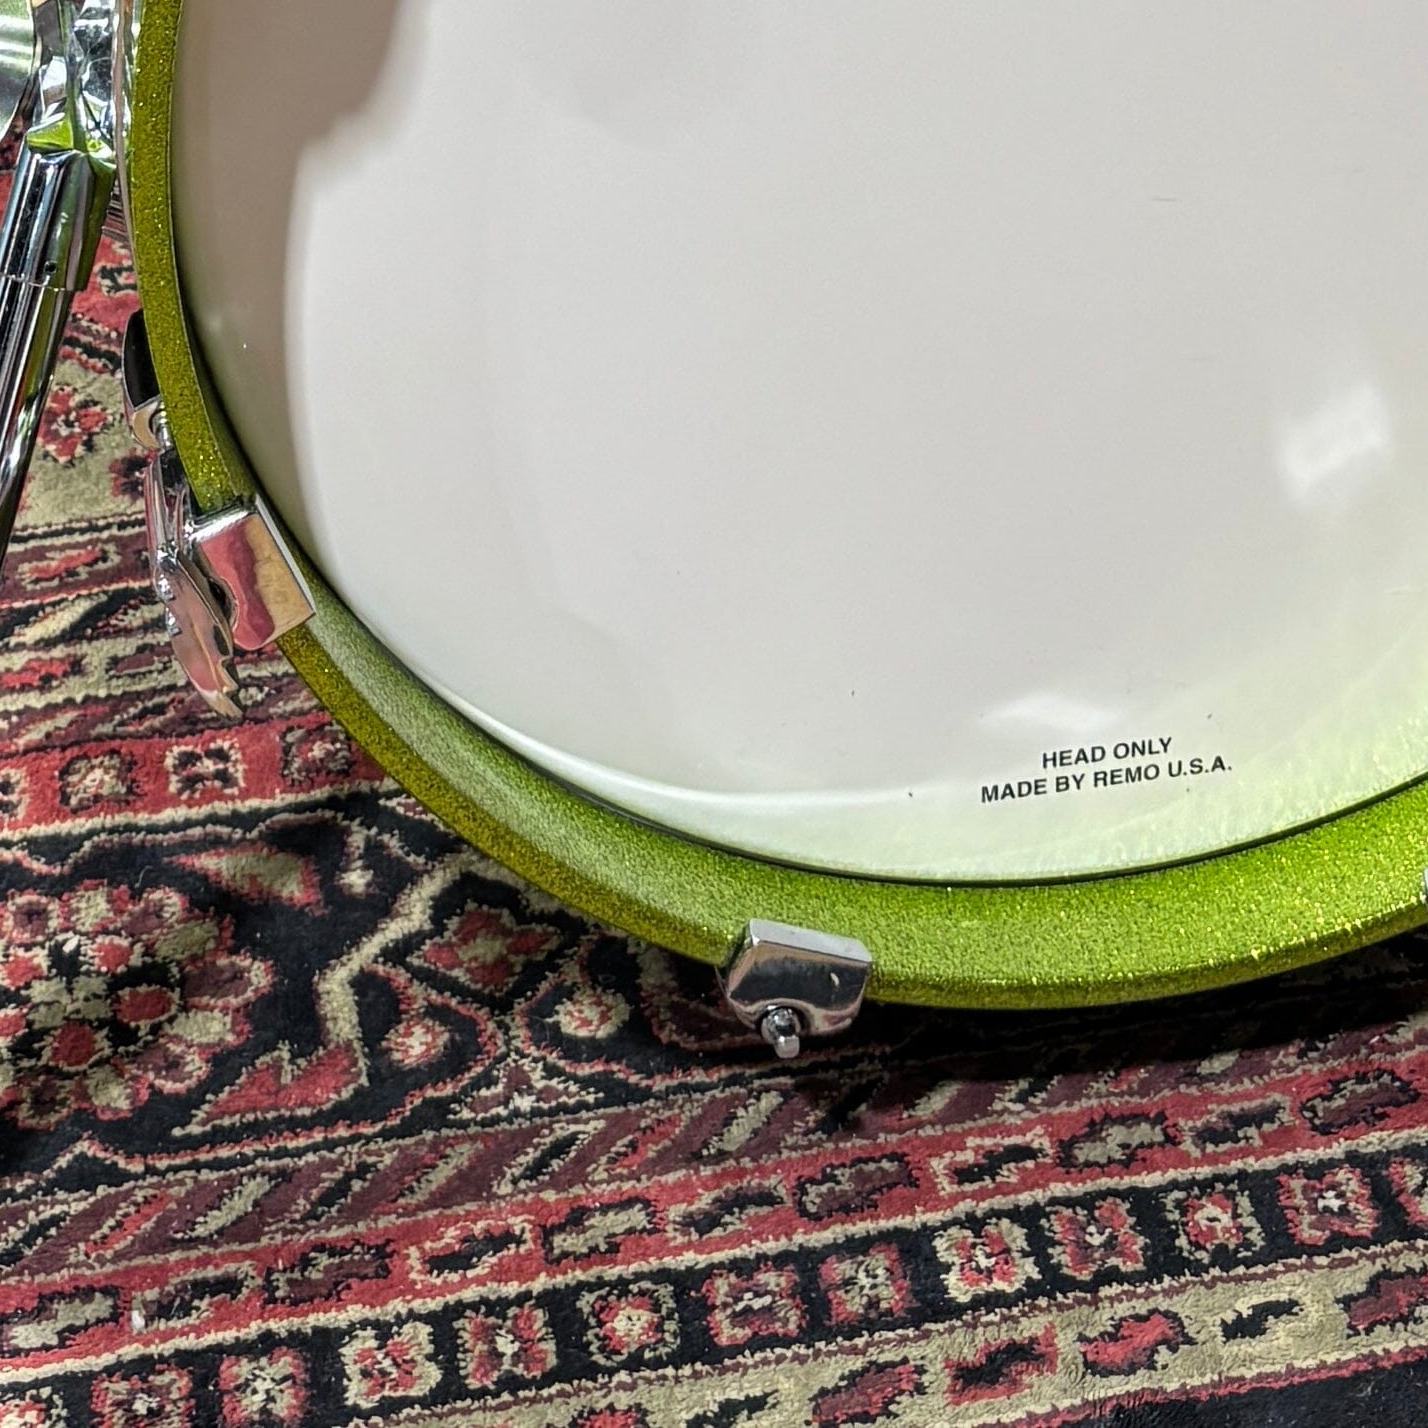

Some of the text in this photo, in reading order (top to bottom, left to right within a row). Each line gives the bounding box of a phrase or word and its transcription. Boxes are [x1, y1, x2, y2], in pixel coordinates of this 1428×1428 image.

[1042, 736, 1172, 769] HEAD ONLY
[981, 755, 1232, 804] MADE BY REMO U.S.A.
